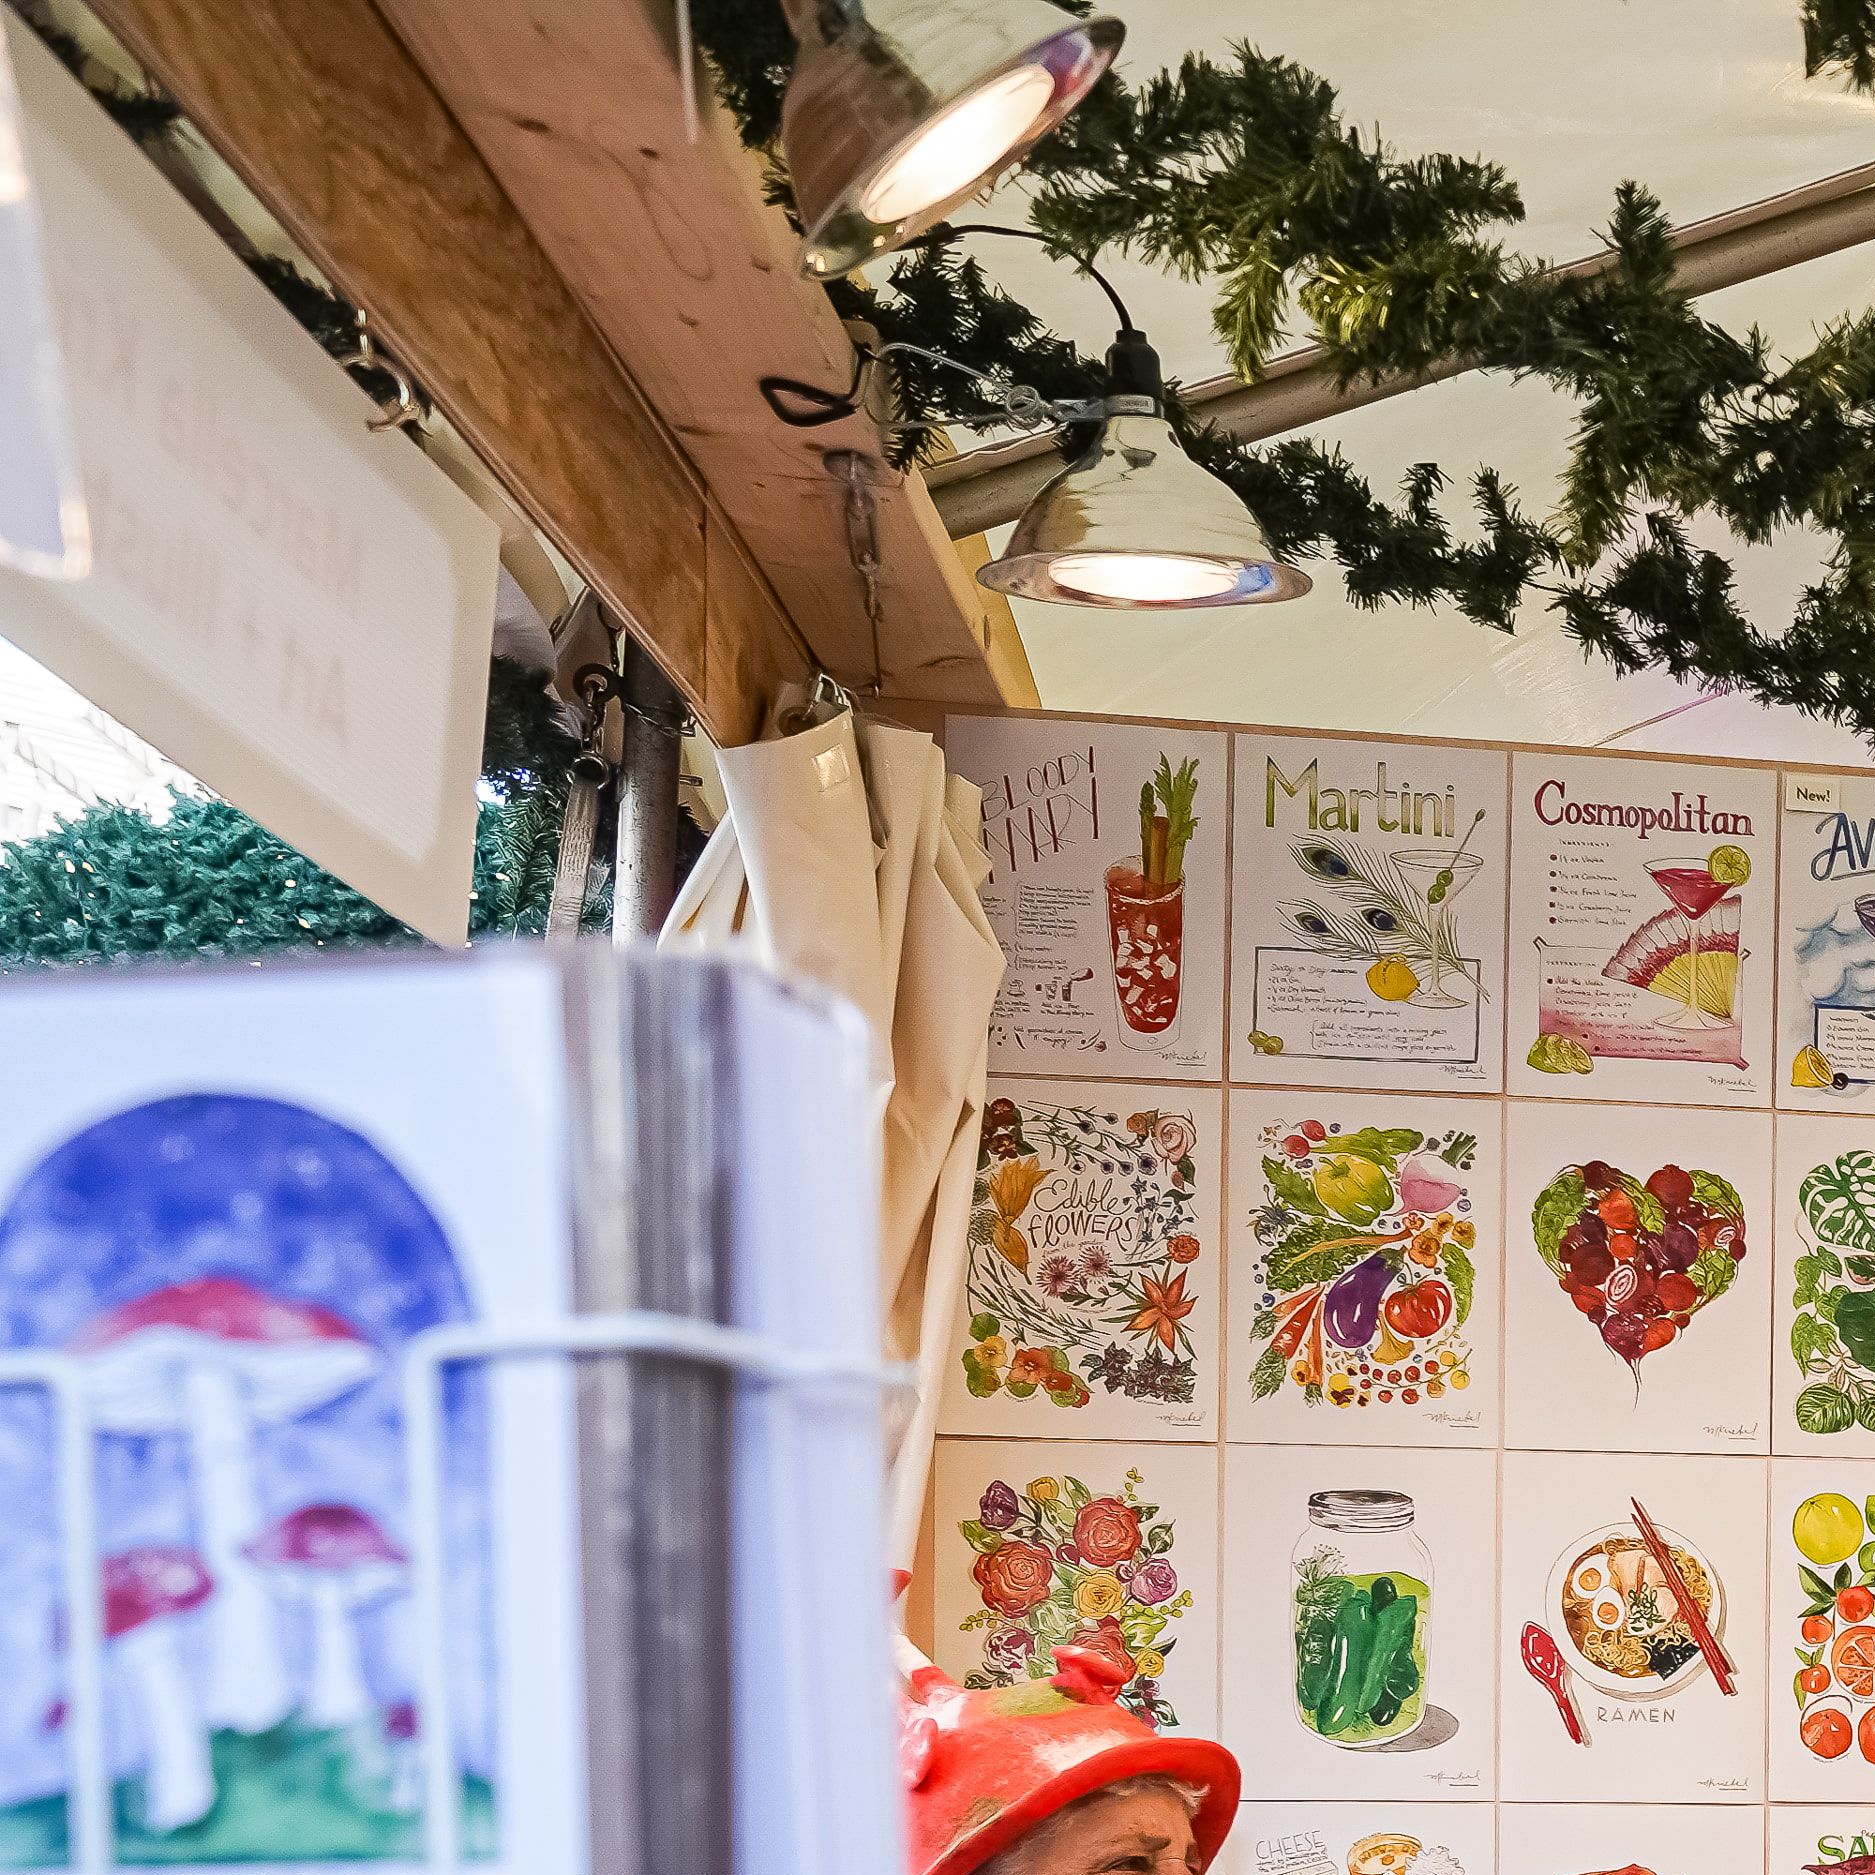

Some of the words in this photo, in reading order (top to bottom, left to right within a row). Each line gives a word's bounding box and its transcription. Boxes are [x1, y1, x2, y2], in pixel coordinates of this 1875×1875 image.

[980, 746, 1095, 822] BLOODY
[1266, 756, 1457, 838] Martini
[1796, 787, 1830, 803] New!
[1534, 779, 1755, 841] Cosmopolitan
[1032, 1178, 1119, 1219] Edible
[1596, 1705, 1676, 1724] RAMEN
[1255, 1829, 1325, 1862] CHEESE
